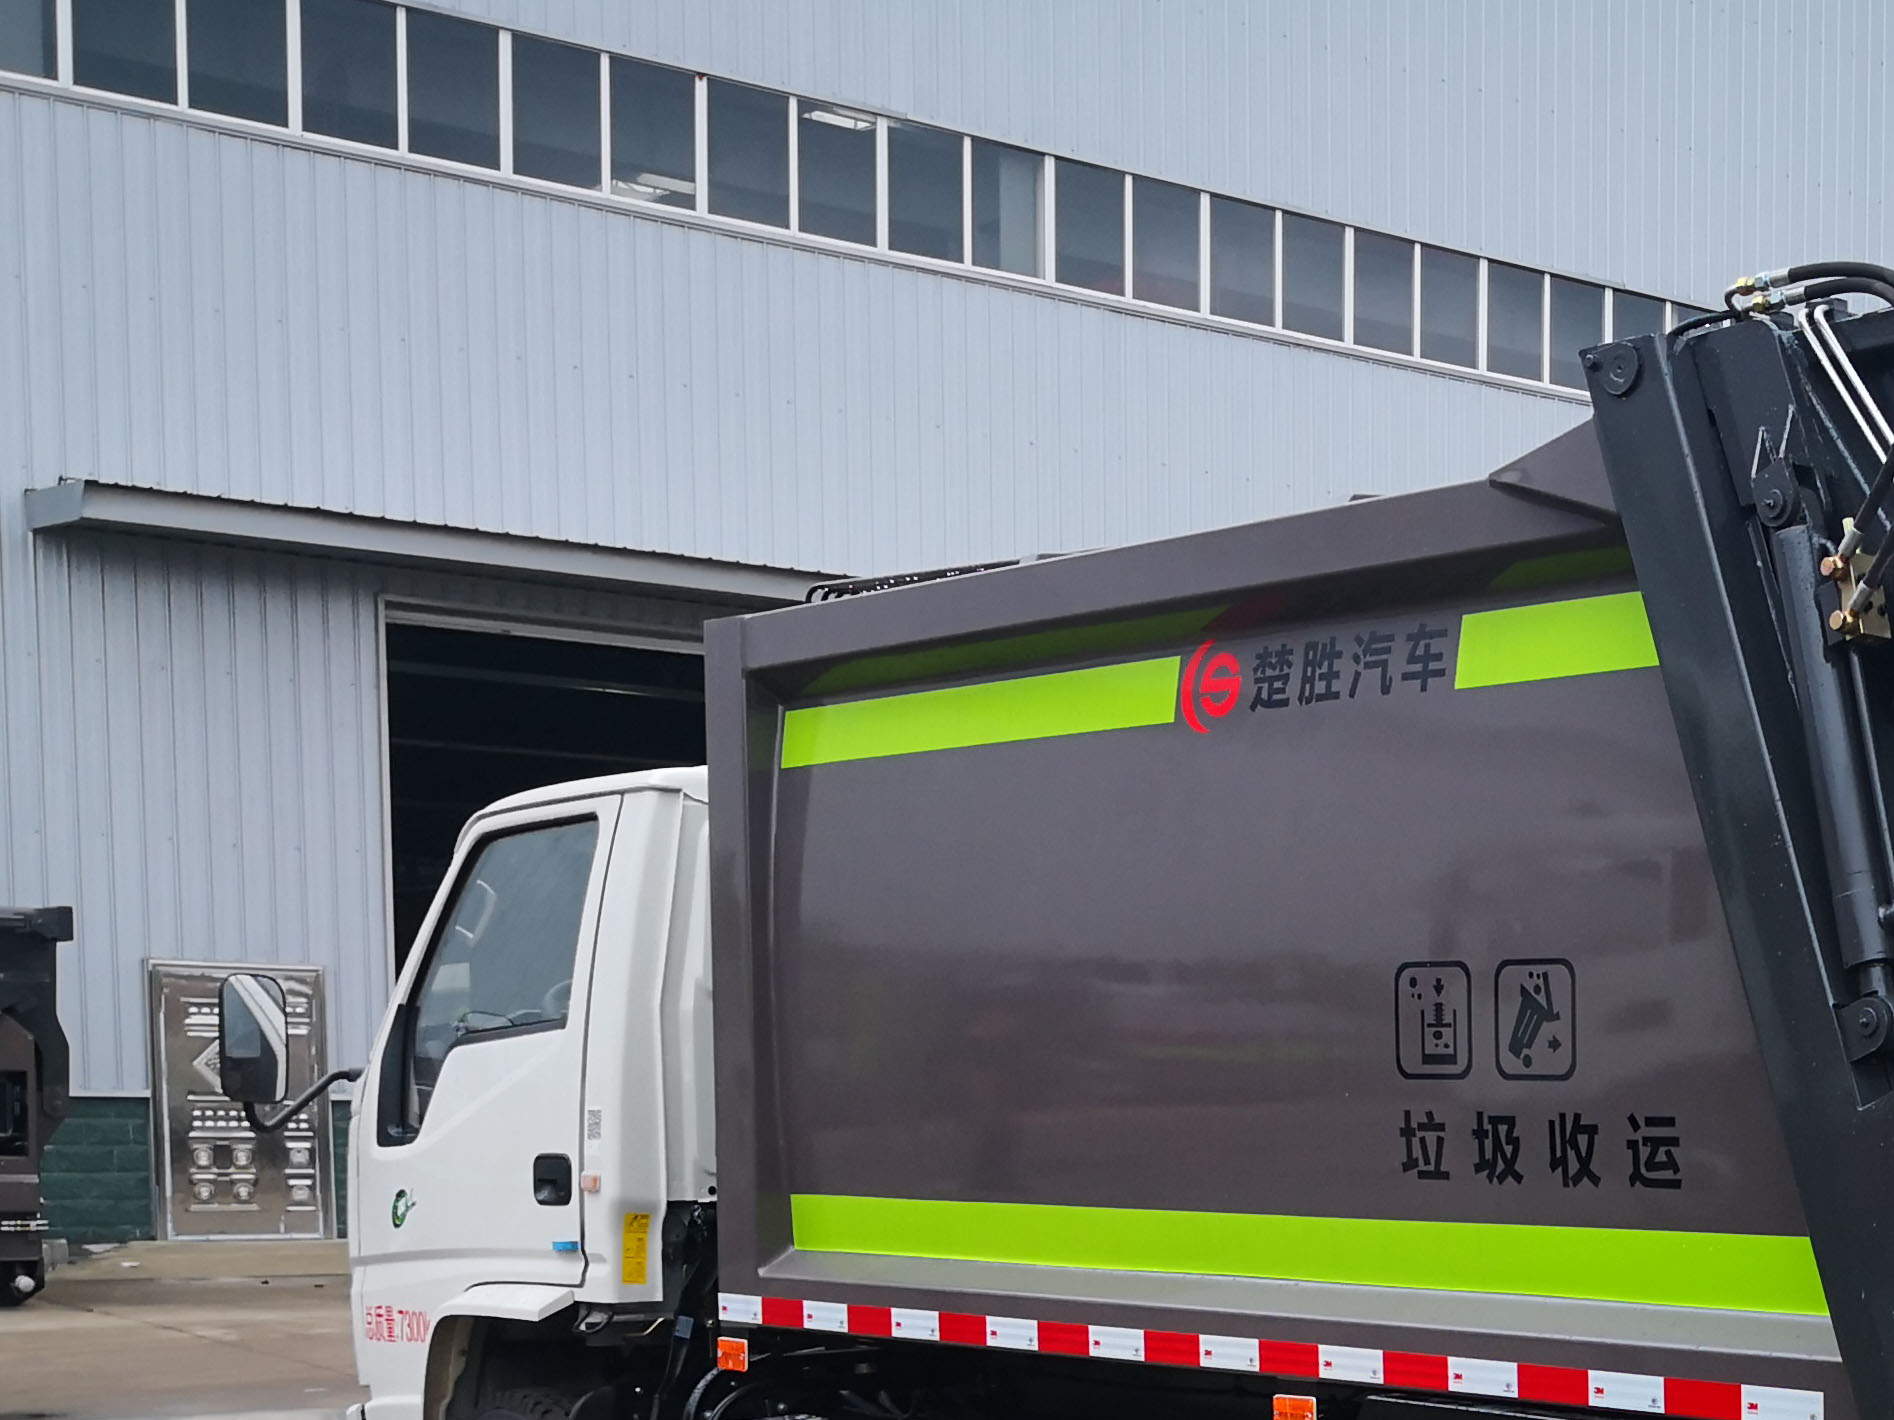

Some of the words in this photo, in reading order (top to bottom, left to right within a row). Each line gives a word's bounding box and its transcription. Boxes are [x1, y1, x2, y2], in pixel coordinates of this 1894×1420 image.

[1249, 623, 1449, 713] 楚胜汽车
[1399, 1109, 1683, 1190] 垃圾收运
